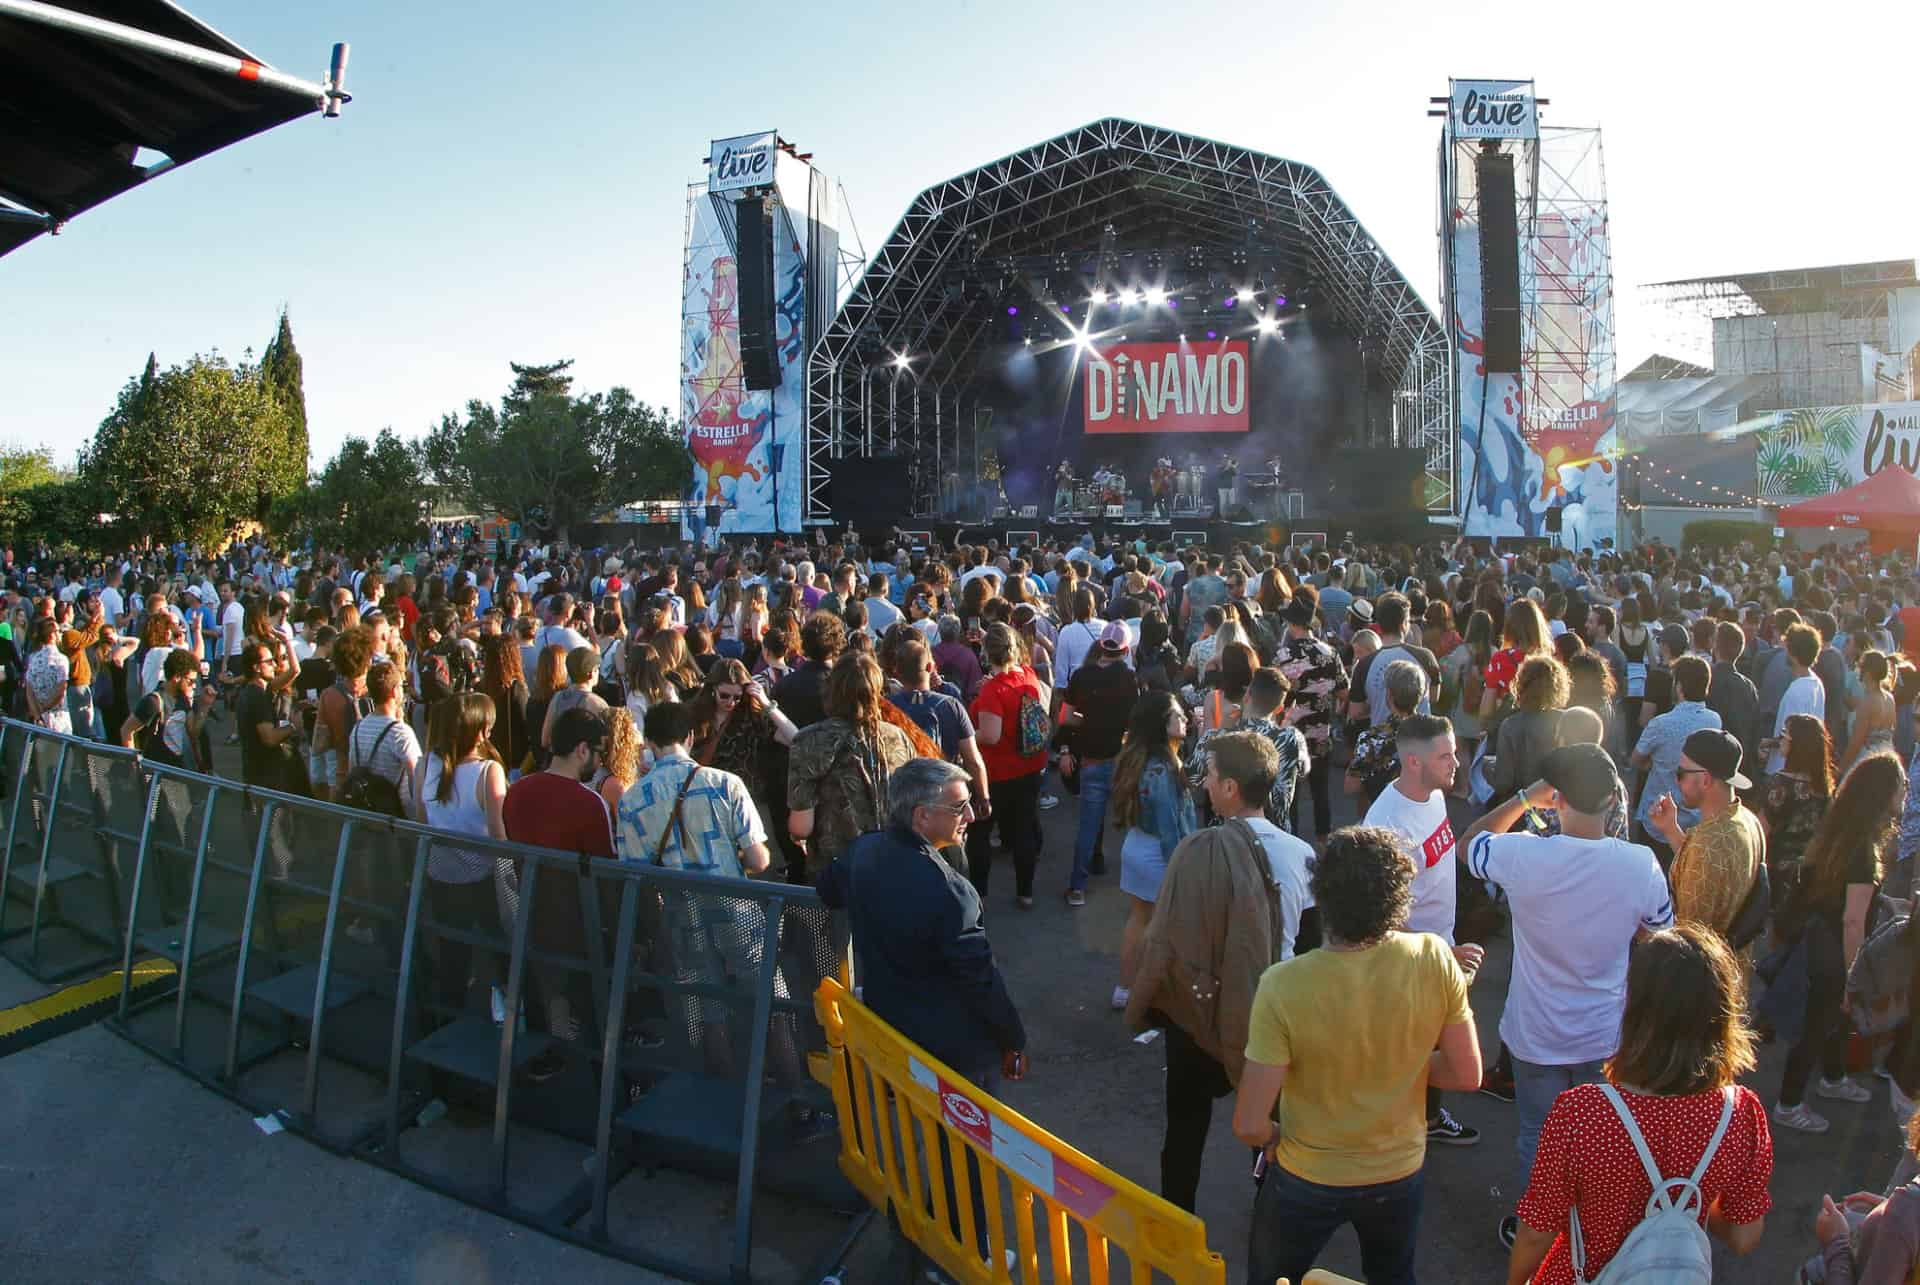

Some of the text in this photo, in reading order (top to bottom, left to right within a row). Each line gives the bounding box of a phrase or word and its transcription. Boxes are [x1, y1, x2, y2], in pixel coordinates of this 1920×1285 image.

[1462, 89, 1527, 126] live
[718, 147, 768, 179] live
[697, 423, 749, 438] ESTRELLA
